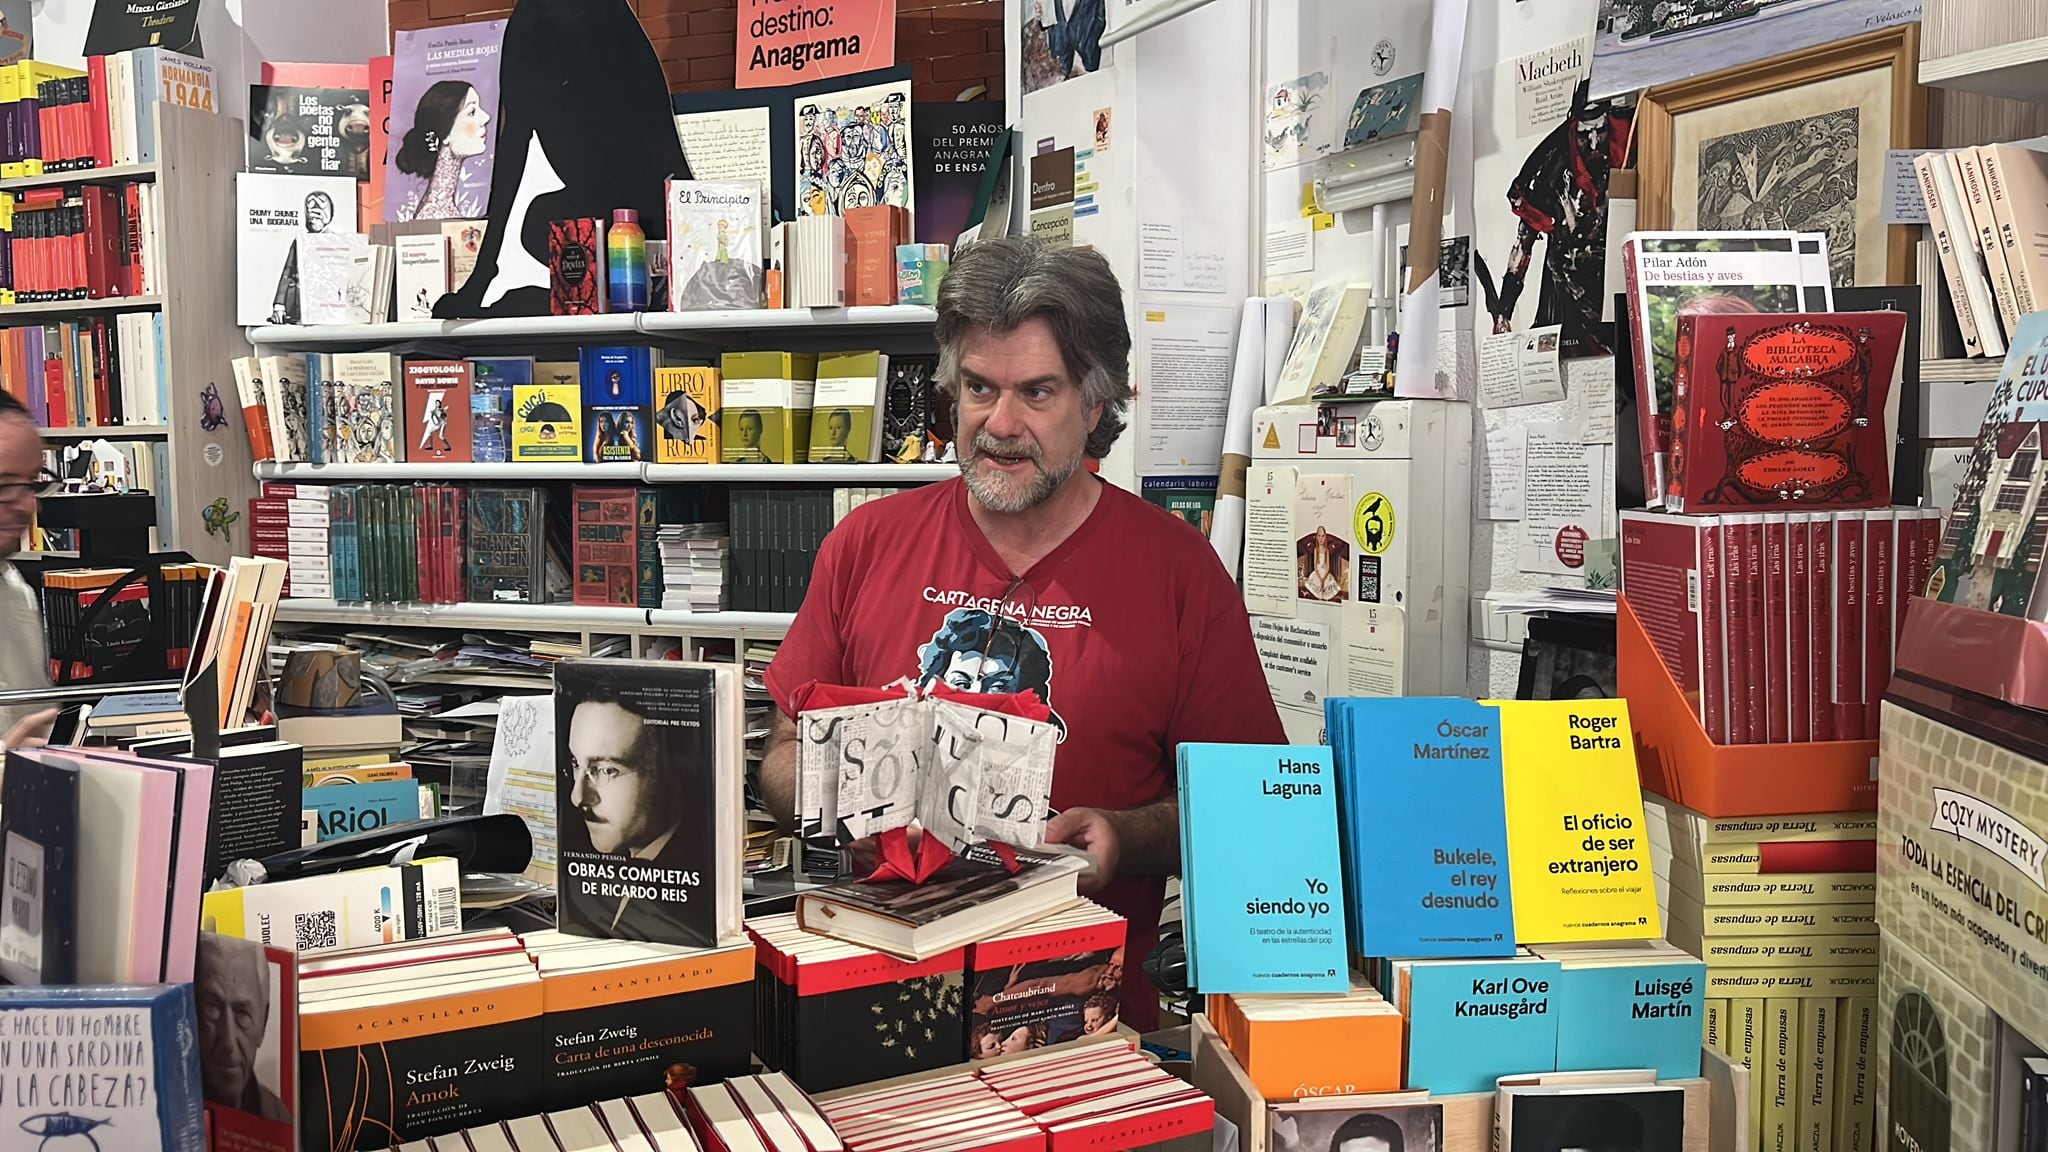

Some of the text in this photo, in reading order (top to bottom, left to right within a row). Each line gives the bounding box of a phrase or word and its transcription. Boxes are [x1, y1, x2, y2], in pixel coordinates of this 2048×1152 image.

[751, 6, 836, 38] destino:
[427, 44, 499, 61] LAS MEDIAS ROJAS
[749, 33, 861, 71] Anagrama
[160, 55, 213, 73] JAMES HOLLAND
[1518, 48, 1582, 84] Macbeth
[162, 80, 213, 113] 1944
[298, 95, 318, 106] Los
[299, 104, 335, 116] poetas
[318, 115, 333, 125] no
[952, 123, 1004, 134] 50 AÑOS
[311, 124, 334, 136] son
[307, 135, 340, 147] gente
[932, 137, 995, 147] DEL PREMI
[321, 147, 337, 159] de
[321, 158, 341, 171] fiar
[935, 163, 986, 173] DE ENSA
[1032, 182, 1056, 194] Dentro
[1986, 157, 2003, 201] KANIKOSEN
[679, 191, 750, 207] El Principito
[250, 209, 299, 218] CHUMY CHUMEZ
[1032, 216, 1069, 231] Concepción
[1642, 256, 1708, 269] Pilar Adón
[1644, 269, 1744, 283] De bestias y aves
[1766, 345, 1837, 355] BIBLIOTECA
[1769, 354, 1829, 364] MACABRA
[409, 364, 464, 375] ZIGGYOLOGÍA
[414, 376, 459, 385] DAVID BOWIE
[660, 372, 705, 393] LIBRO
[518, 388, 547, 419] CUCÚ
[603, 446, 631, 455] ASISTENTA
[666, 438, 706, 458] ROJO
[579, 525, 623, 542] BELLA
[473, 535, 530, 551] FRANKEN
[491, 551, 530, 566] STEIN
[922, 586, 1092, 622] CARTAGENA NEGRA
[1260, 648, 1279, 658] Complaint
[1279, 651, 1291, 660] sheets
[1299, 656, 1318, 666] available
[1276, 664, 1297, 674] customer's
[1297, 668, 1312, 676] service
[1436, 719, 1489, 738] Óscar
[1568, 713, 1618, 733] Roger
[1413, 742, 1490, 760] Martínez
[1569, 734, 1621, 750] Bartra
[1278, 758, 1321, 774] Hans
[1262, 779, 1322, 800] Laguna
[1563, 813, 1633, 832] El oficio
[1941, 799, 1974, 830] COZY
[1714, 822, 1764, 832] empusas
[1765, 821, 1780, 832] de
[1782, 821, 1818, 832] Tierra
[1581, 836, 1635, 852] de ser
[1976, 812, 2039, 868] MYSTERY
[563, 851, 627, 862] FERNANDO PESSOA
[1433, 848, 1498, 866] Bukele,
[1710, 855, 1760, 864] empusas
[567, 861, 700, 886] OBRAS COMPLETAS
[1548, 857, 1639, 875] extranjero
[1304, 878, 1329, 894] Yo
[1450, 870, 1498, 891] el rey
[1902, 835, 1929, 871] TODA
[1930, 853, 1944, 881] LA
[1946, 861, 1993, 917] ESENCIA
[1995, 893, 2021, 929] DEL
[581, 881, 688, 903] DE RICARDO REIS
[1561, 885, 1642, 895] Reflexiones sobre el viajar
[1246, 898, 1330, 918] siendo yo
[1421, 892, 1500, 910] desnudo
[374, 915, 382, 933] 4000
[1292, 927, 1332, 935] autenticidad
[1581, 920, 1610, 928] cuadernos
[1610, 919, 1637, 927] anagrama
[1008, 936, 1096, 956] ACANTILADO
[1270, 936, 1280, 944] las
[1281, 936, 1308, 944] estrellas
[1307, 936, 1318, 944] del
[1318, 937, 1333, 946] pop
[590, 967, 714, 992] ACANTILADO
[1472, 977, 1549, 995] Karl Ove
[1634, 976, 1694, 997] Luisgé
[992, 982, 1057, 1004] Chateaubriand
[1454, 997, 1548, 1019] Knausgård
[1631, 1002, 1692, 1019] Martín
[13, 1014, 142, 1036] HACE UN HOMBRE
[554, 1025, 639, 1048] Stefan Zweig
[1741, 1007, 1754, 1070] de empusas
[554, 1027, 714, 1066] Carta de una desconocida
[405, 1054, 516, 1085] Stefan Zweig
[556, 1065, 601, 1078] TRADUCCIÓN
[613, 1059, 635, 1067] BERTA
[635, 1053, 661, 1064] CONILL
[17, 1074, 146, 1108] LA CABEZA?
[405, 1083, 461, 1107] Amok
[405, 1108, 483, 1129] JOAN FONTCUBERTA
[406, 1105, 456, 1119] TRADUCCIÓN
